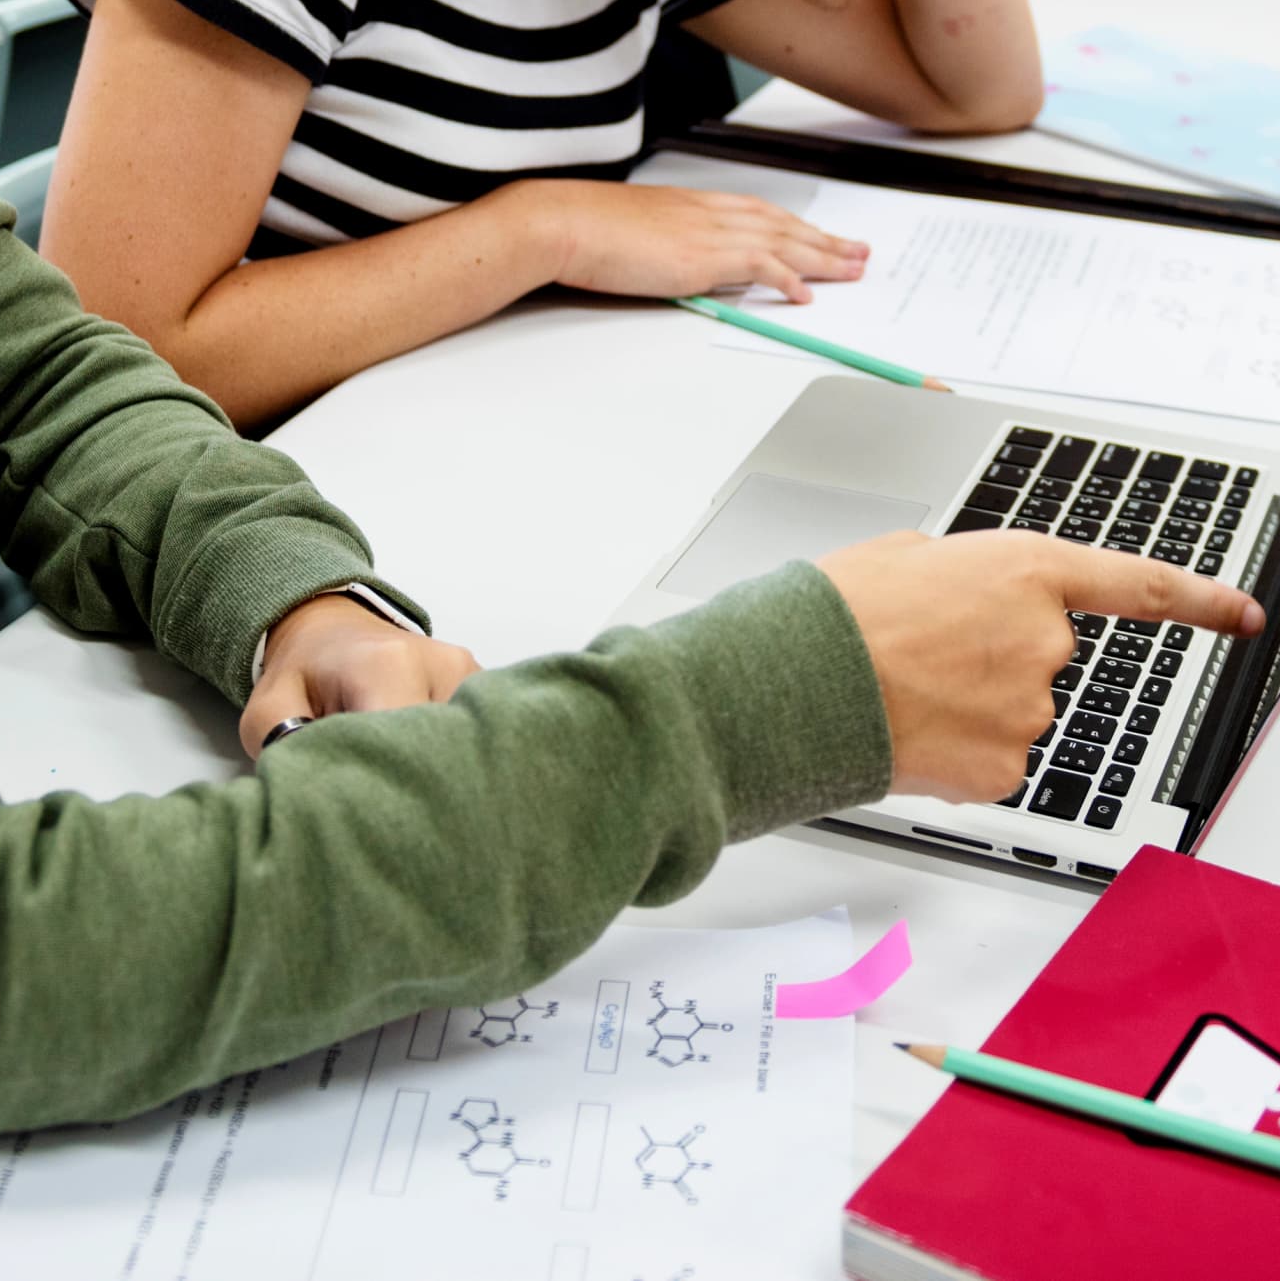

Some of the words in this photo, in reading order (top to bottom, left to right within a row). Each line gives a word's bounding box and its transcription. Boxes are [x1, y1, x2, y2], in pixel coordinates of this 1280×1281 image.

[1115, 634, 1129, 642] 8
[1104, 659, 1118, 667] 9
[1038, 787, 1054, 806] delete
[763, 973, 776, 1012] Exercise
[759, 1051, 770, 1065] the
